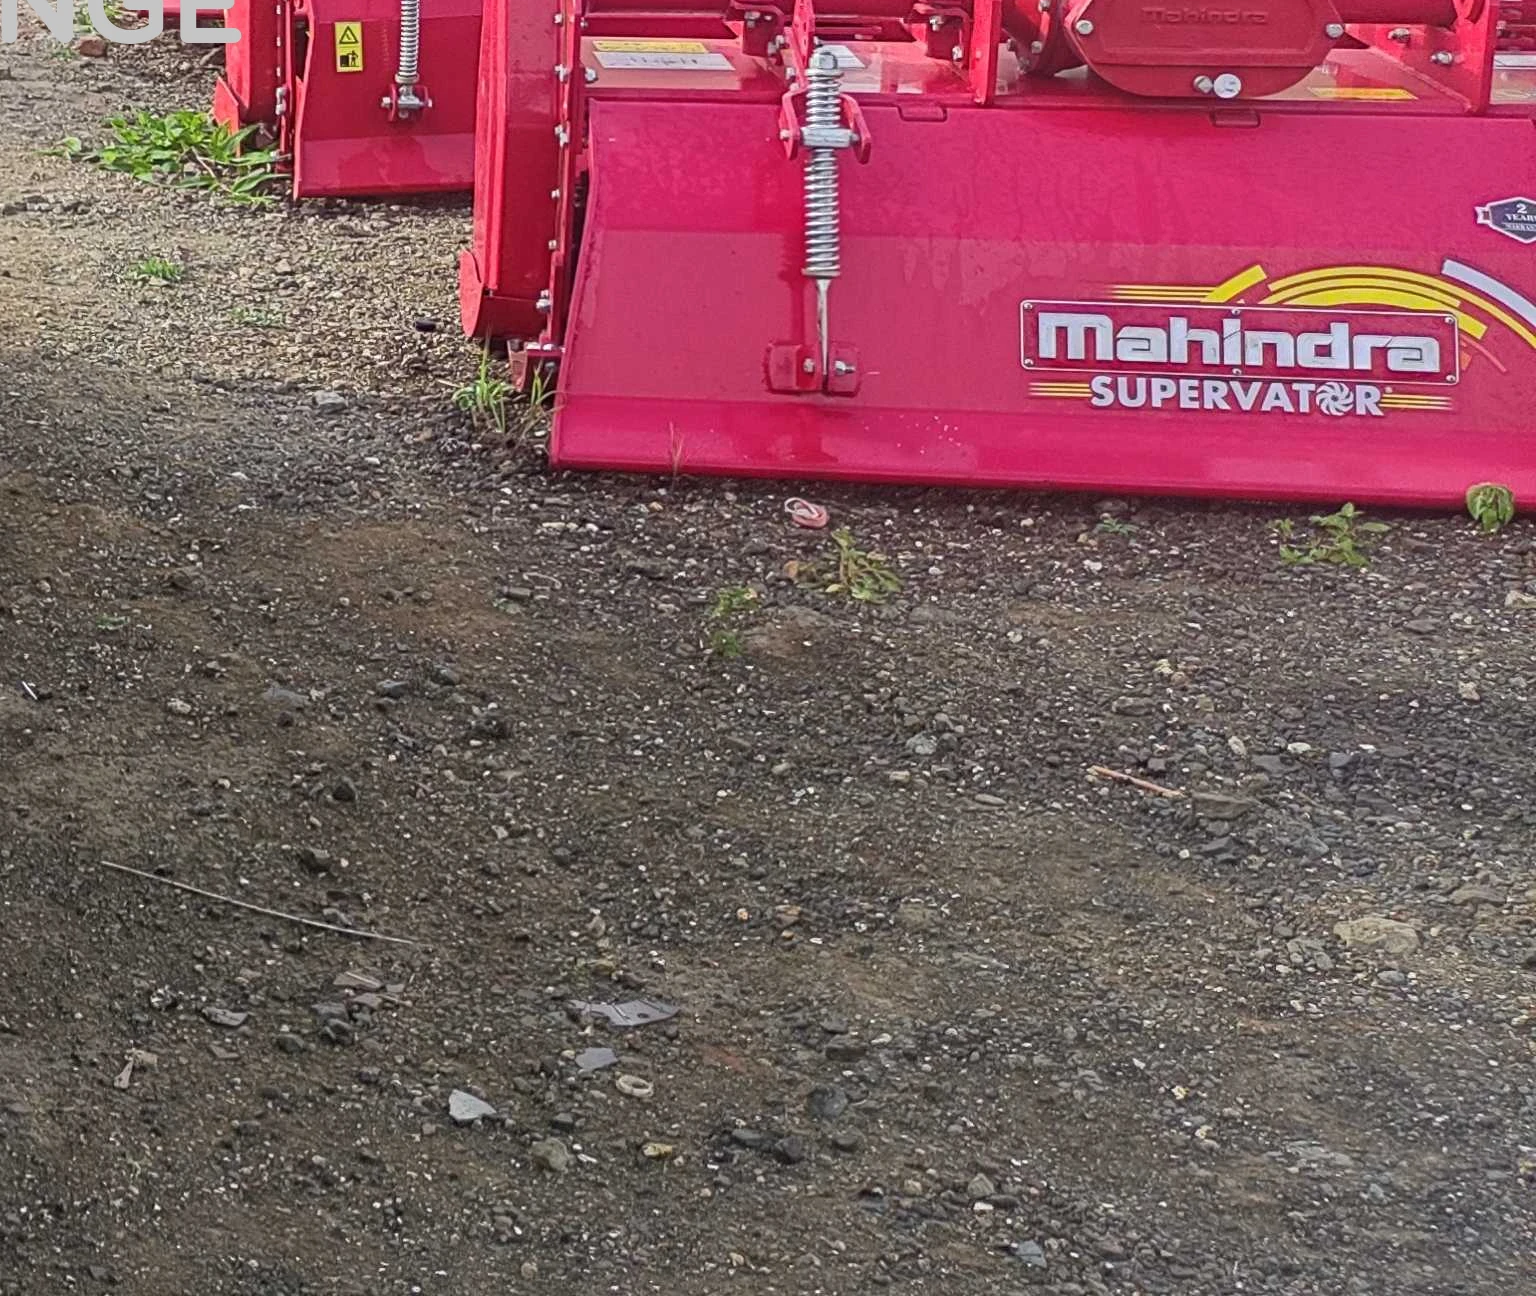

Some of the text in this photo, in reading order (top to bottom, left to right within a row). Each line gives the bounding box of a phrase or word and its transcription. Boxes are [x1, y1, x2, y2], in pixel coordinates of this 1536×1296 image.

[1141, 7, 1270, 25] Mahindra
[1516, 203, 1528, 214] 2
[1038, 311, 1441, 373] Mahindra
[1090, 375, 1385, 417] SUPERVATOR
